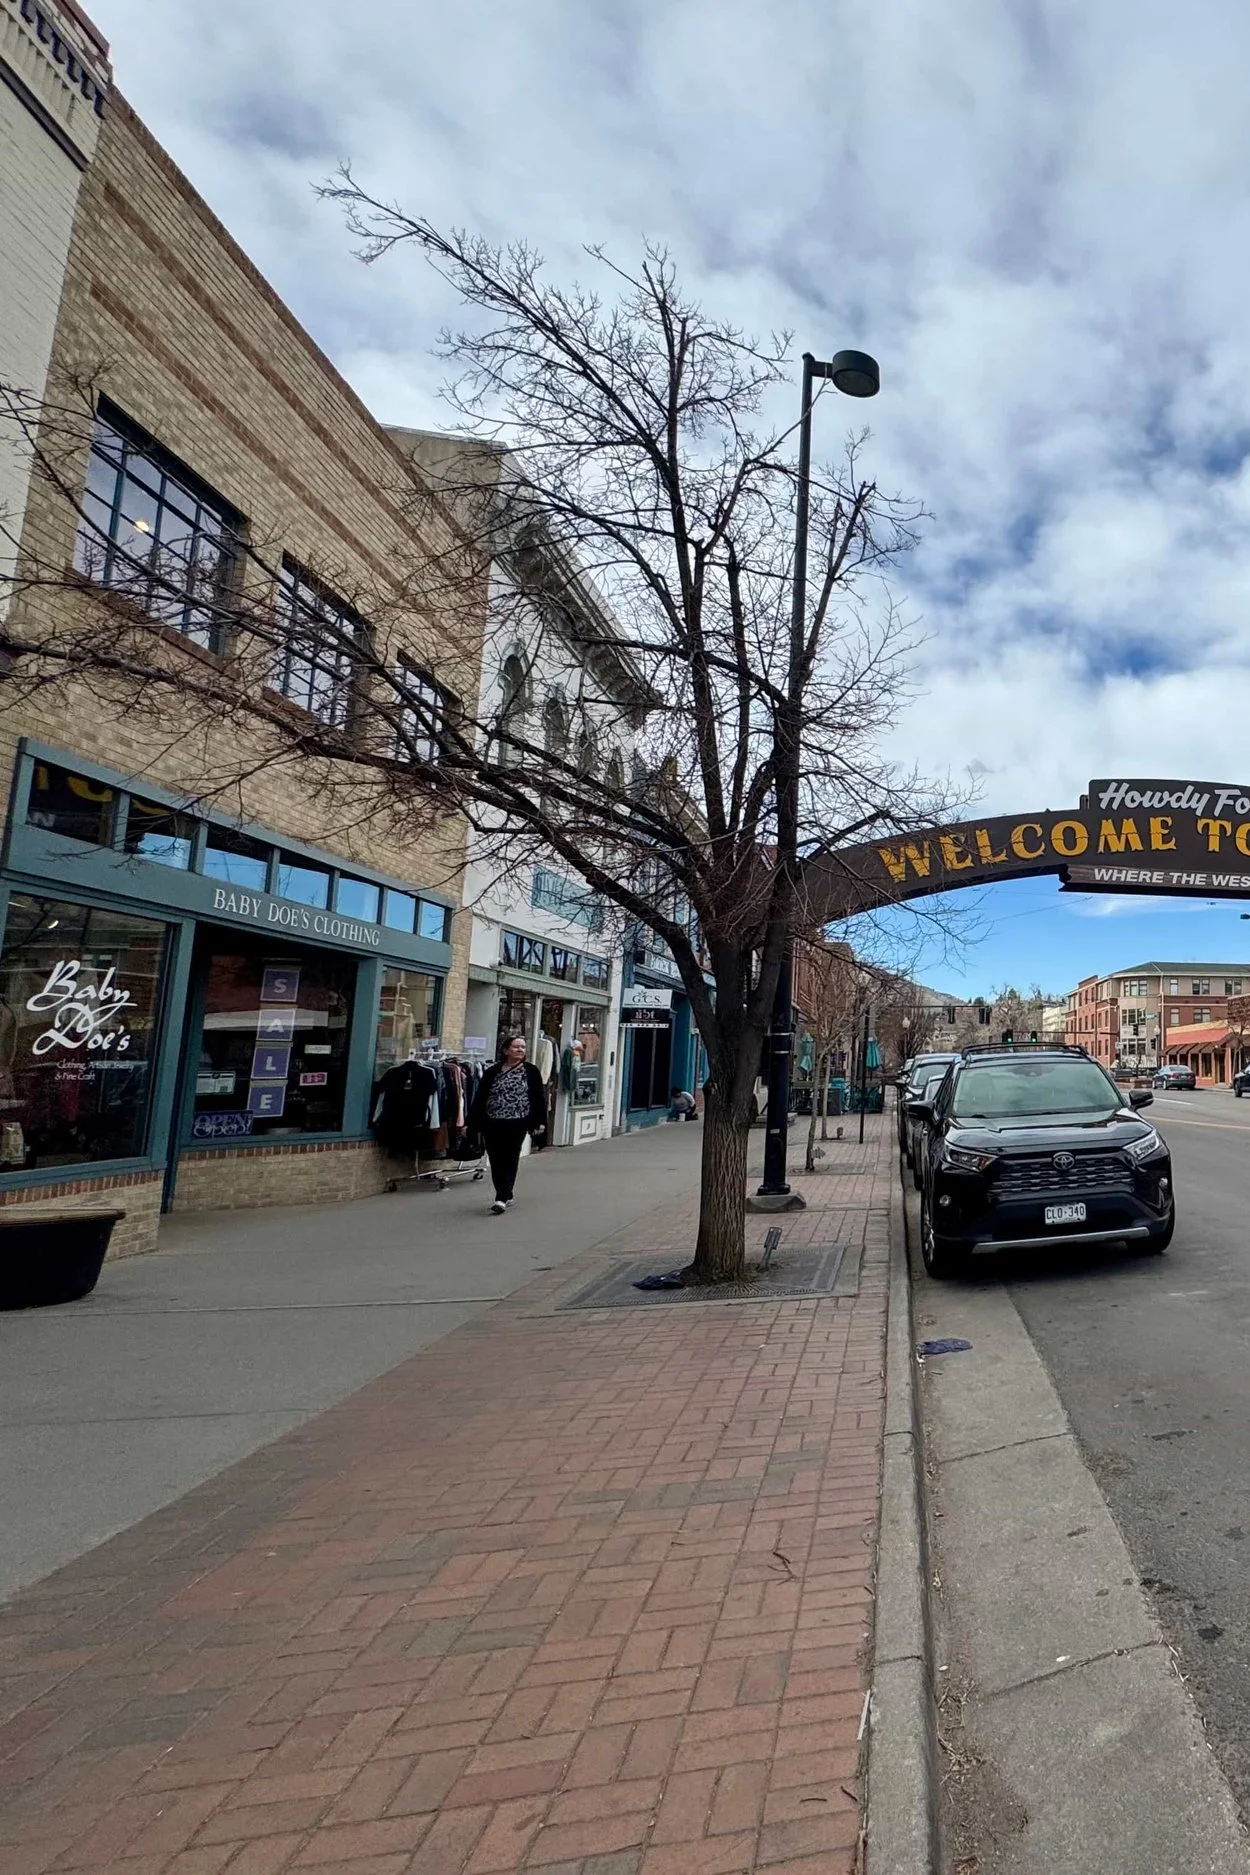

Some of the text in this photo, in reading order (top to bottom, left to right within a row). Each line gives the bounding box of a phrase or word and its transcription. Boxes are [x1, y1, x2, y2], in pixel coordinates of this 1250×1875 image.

[1098, 781, 1211, 816] Howdy
[879, 816, 1177, 884] WELCOME
[1094, 868, 1164, 883] WHERE
[1169, 872, 1207, 885] THE
[213, 888, 381, 946] BABY DOE'S CLOTHING
[26, 960, 138, 1028] Baby
[32, 1002, 131, 1055] Doe's
[259, 978, 289, 1110] SALE
